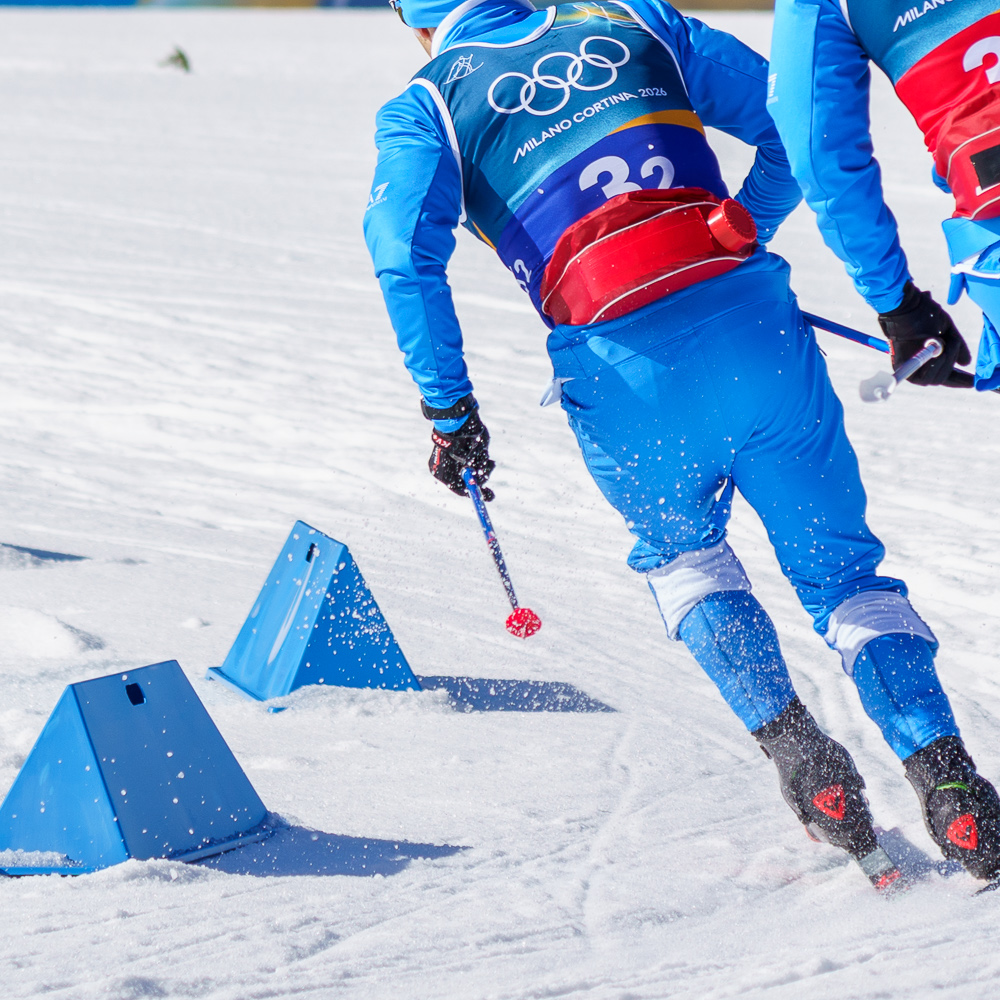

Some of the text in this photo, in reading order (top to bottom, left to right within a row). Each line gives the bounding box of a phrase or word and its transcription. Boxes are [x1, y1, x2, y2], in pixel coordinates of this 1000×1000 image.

[512, 86, 668, 164] MILANO CORTINA 2026
